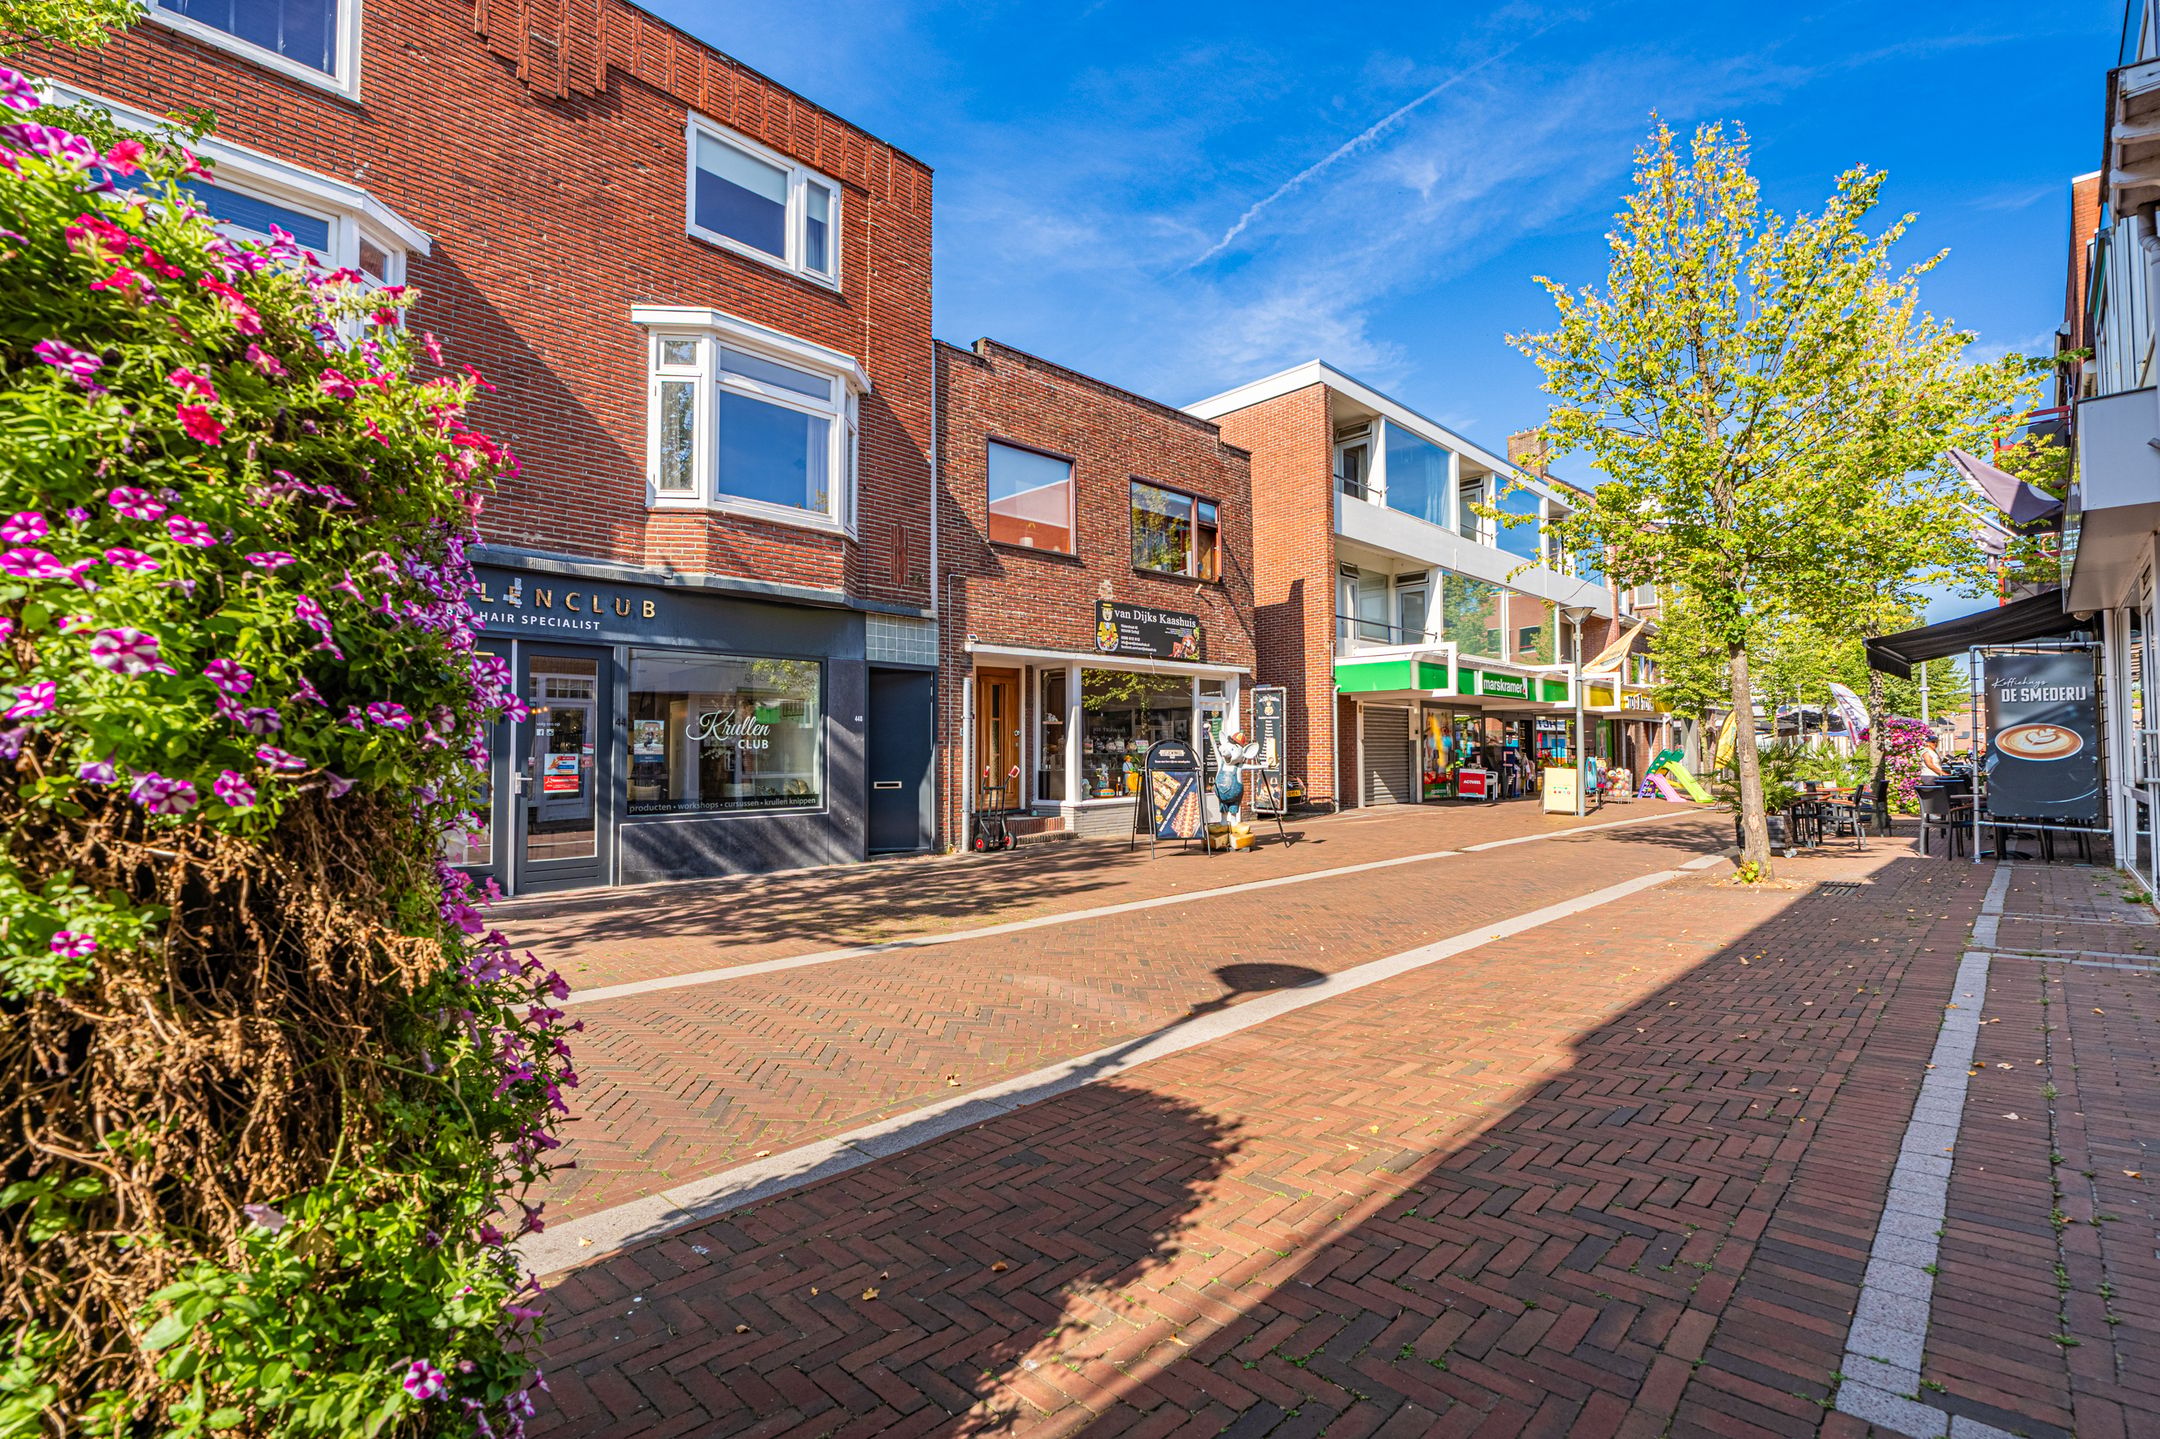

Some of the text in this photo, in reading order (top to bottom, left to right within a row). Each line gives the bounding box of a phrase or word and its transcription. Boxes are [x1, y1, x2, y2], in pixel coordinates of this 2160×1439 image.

[480, 581, 656, 618] LENCLUB
[479, 611, 515, 623] HAIR
[521, 615, 600, 631] SPECIALIST
[1114, 609, 1196, 628] van Dijks Kaashuis
[2001, 686, 2086, 702] DE SMEDERIJ
[685, 708, 771, 741] Krullen
[737, 739, 769, 749] CLUB
[629, 796, 816, 814] producten workshops cursussen krullen knippen
